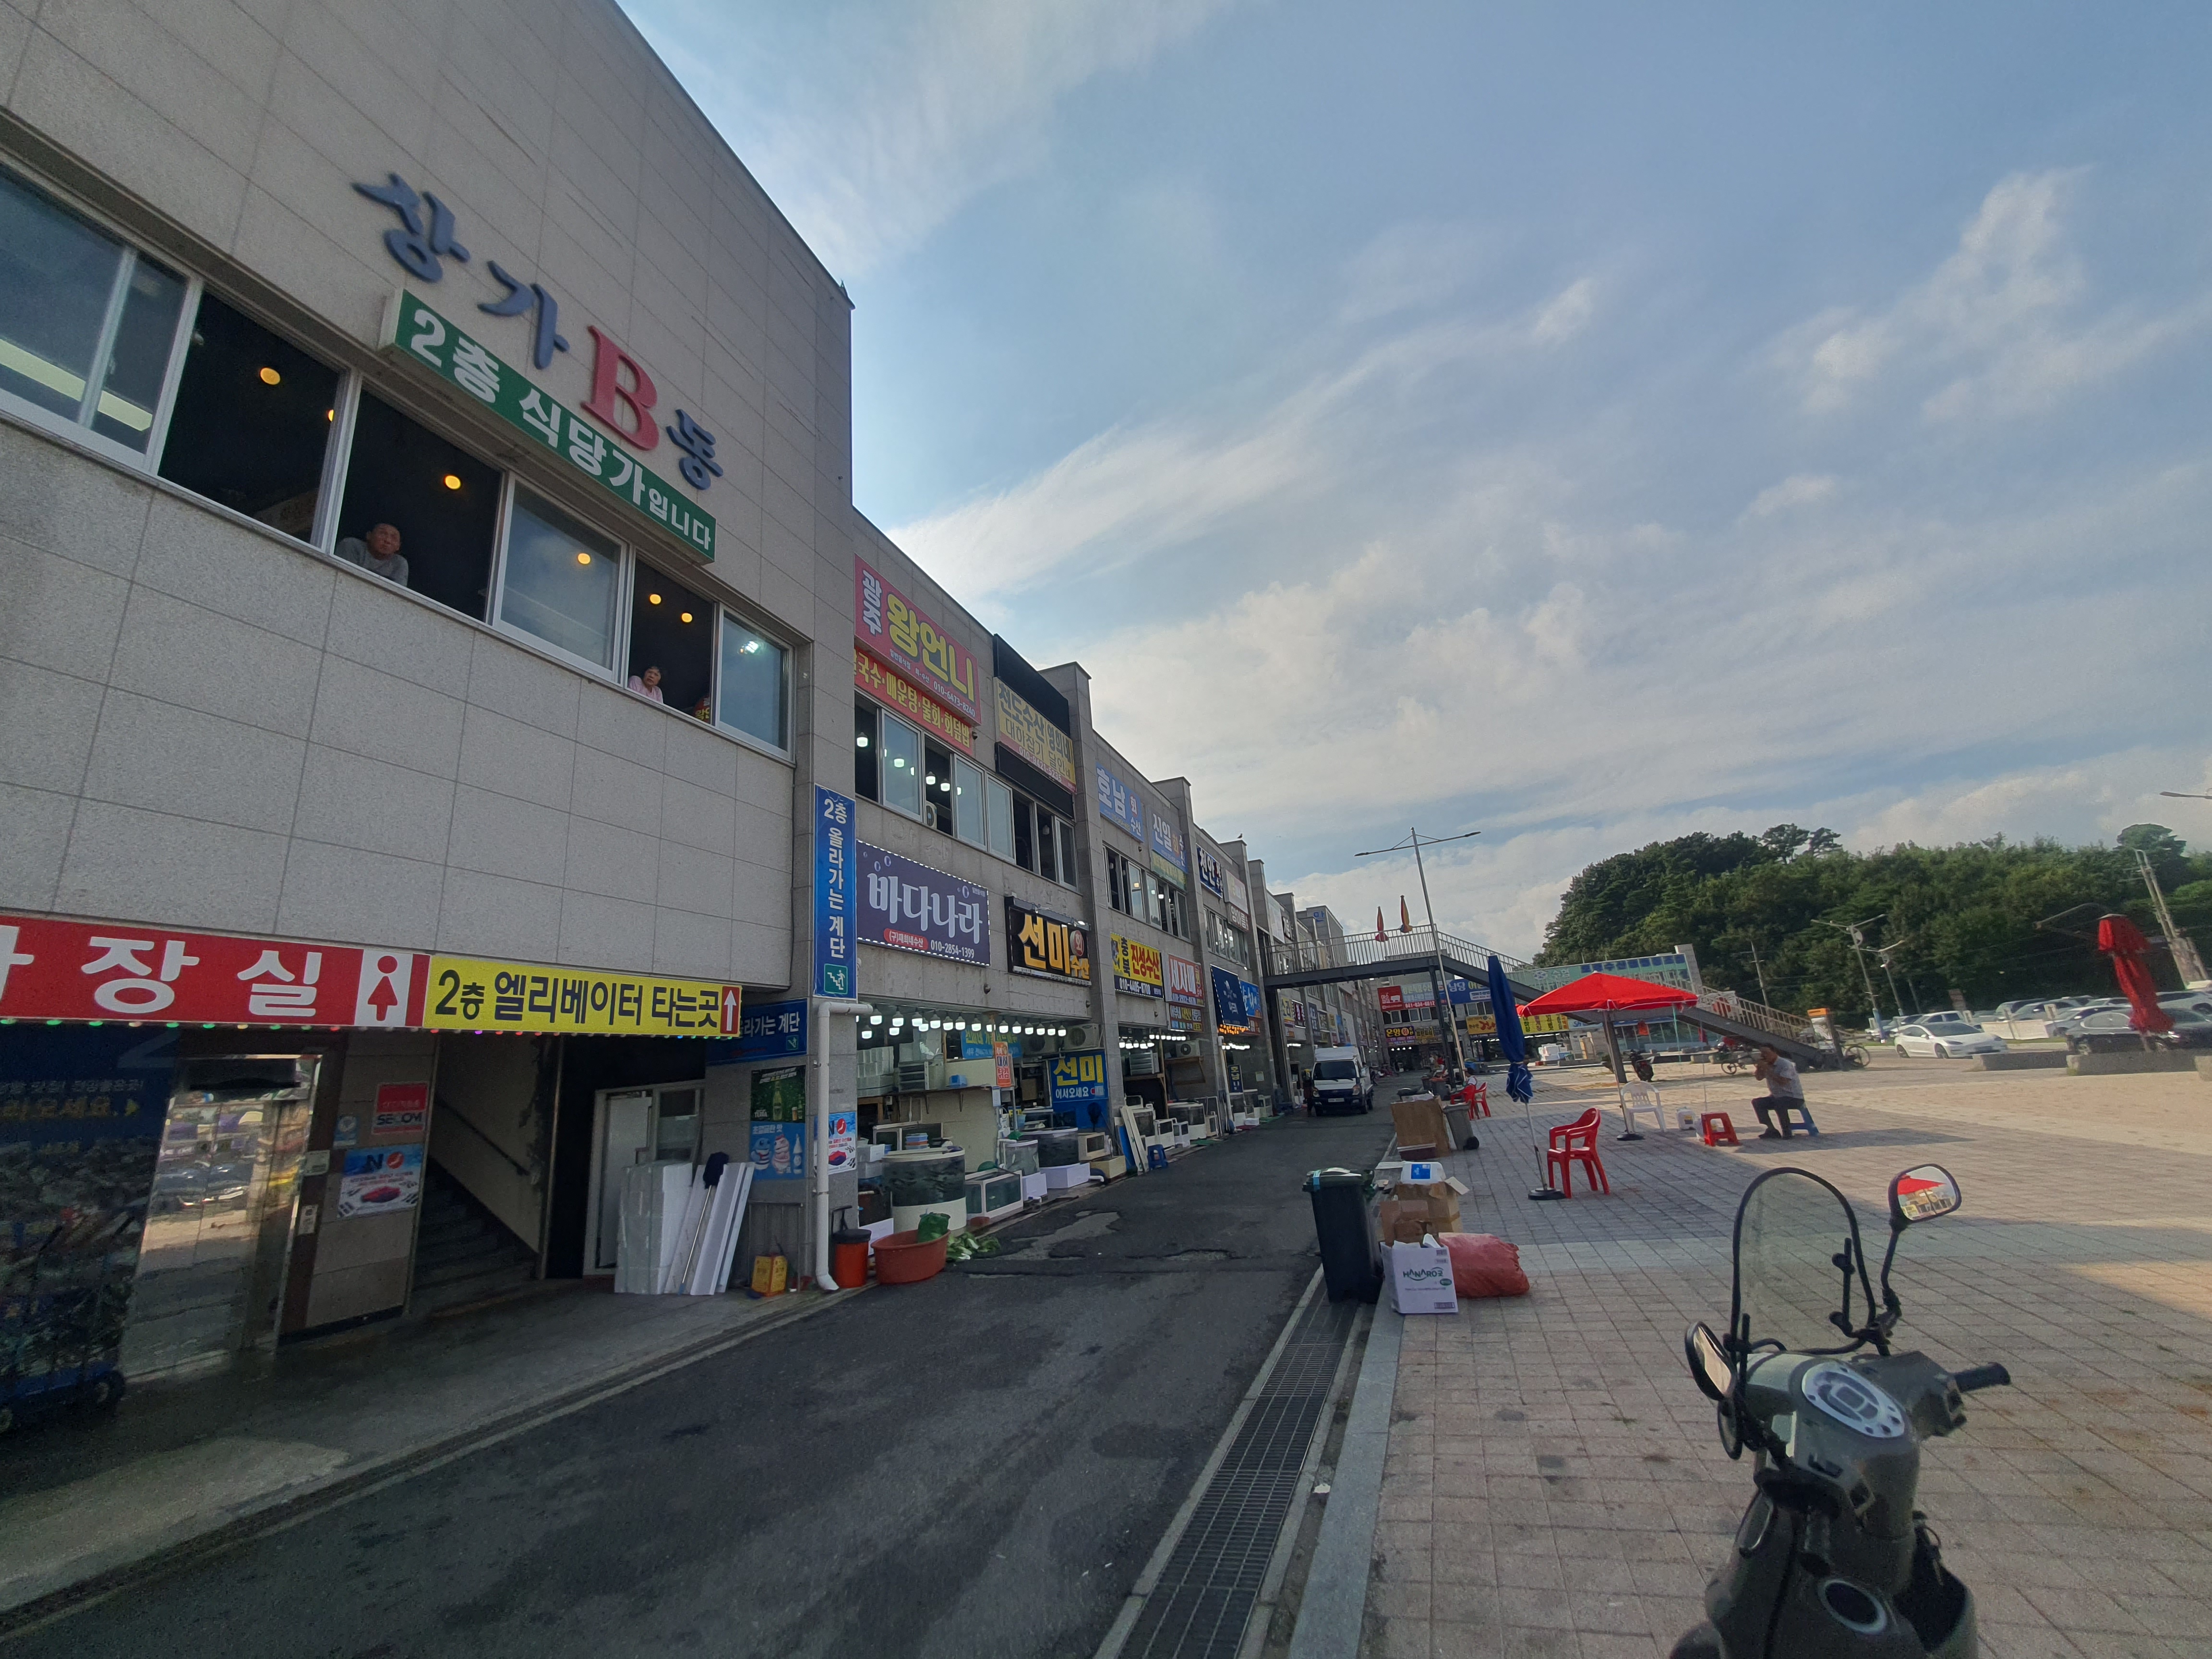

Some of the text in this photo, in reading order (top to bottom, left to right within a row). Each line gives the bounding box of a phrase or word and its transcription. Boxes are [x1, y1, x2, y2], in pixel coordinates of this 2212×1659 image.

[410, 309, 711, 551] 2층 식당가입니다
[863, 570, 882, 635] 광주
[888, 594, 974, 703] 왕언니
[934, 681, 975, 717] 010-6473-8240
[1006, 718, 1044, 760] 대하잡기
[1097, 768, 1126, 819] 호남
[1131, 817, 1141, 836] 수산
[824, 799, 847, 959] 2층 올라가는 계단
[867, 873, 983, 944] 바다나라
[931, 940, 974, 959] 010-2854-1399
[1018, 913, 1070, 974] 선미
[1075, 933, 1082, 951] 회
[1130, 945, 1160, 980] 진성수산
[1070, 955, 1090, 980] 수산
[435, 969, 719, 1028] 2층 엘리베이터 타는곳
[778, 1011, 800, 1033] 계단
[1053, 1055, 1104, 1086] 선미
